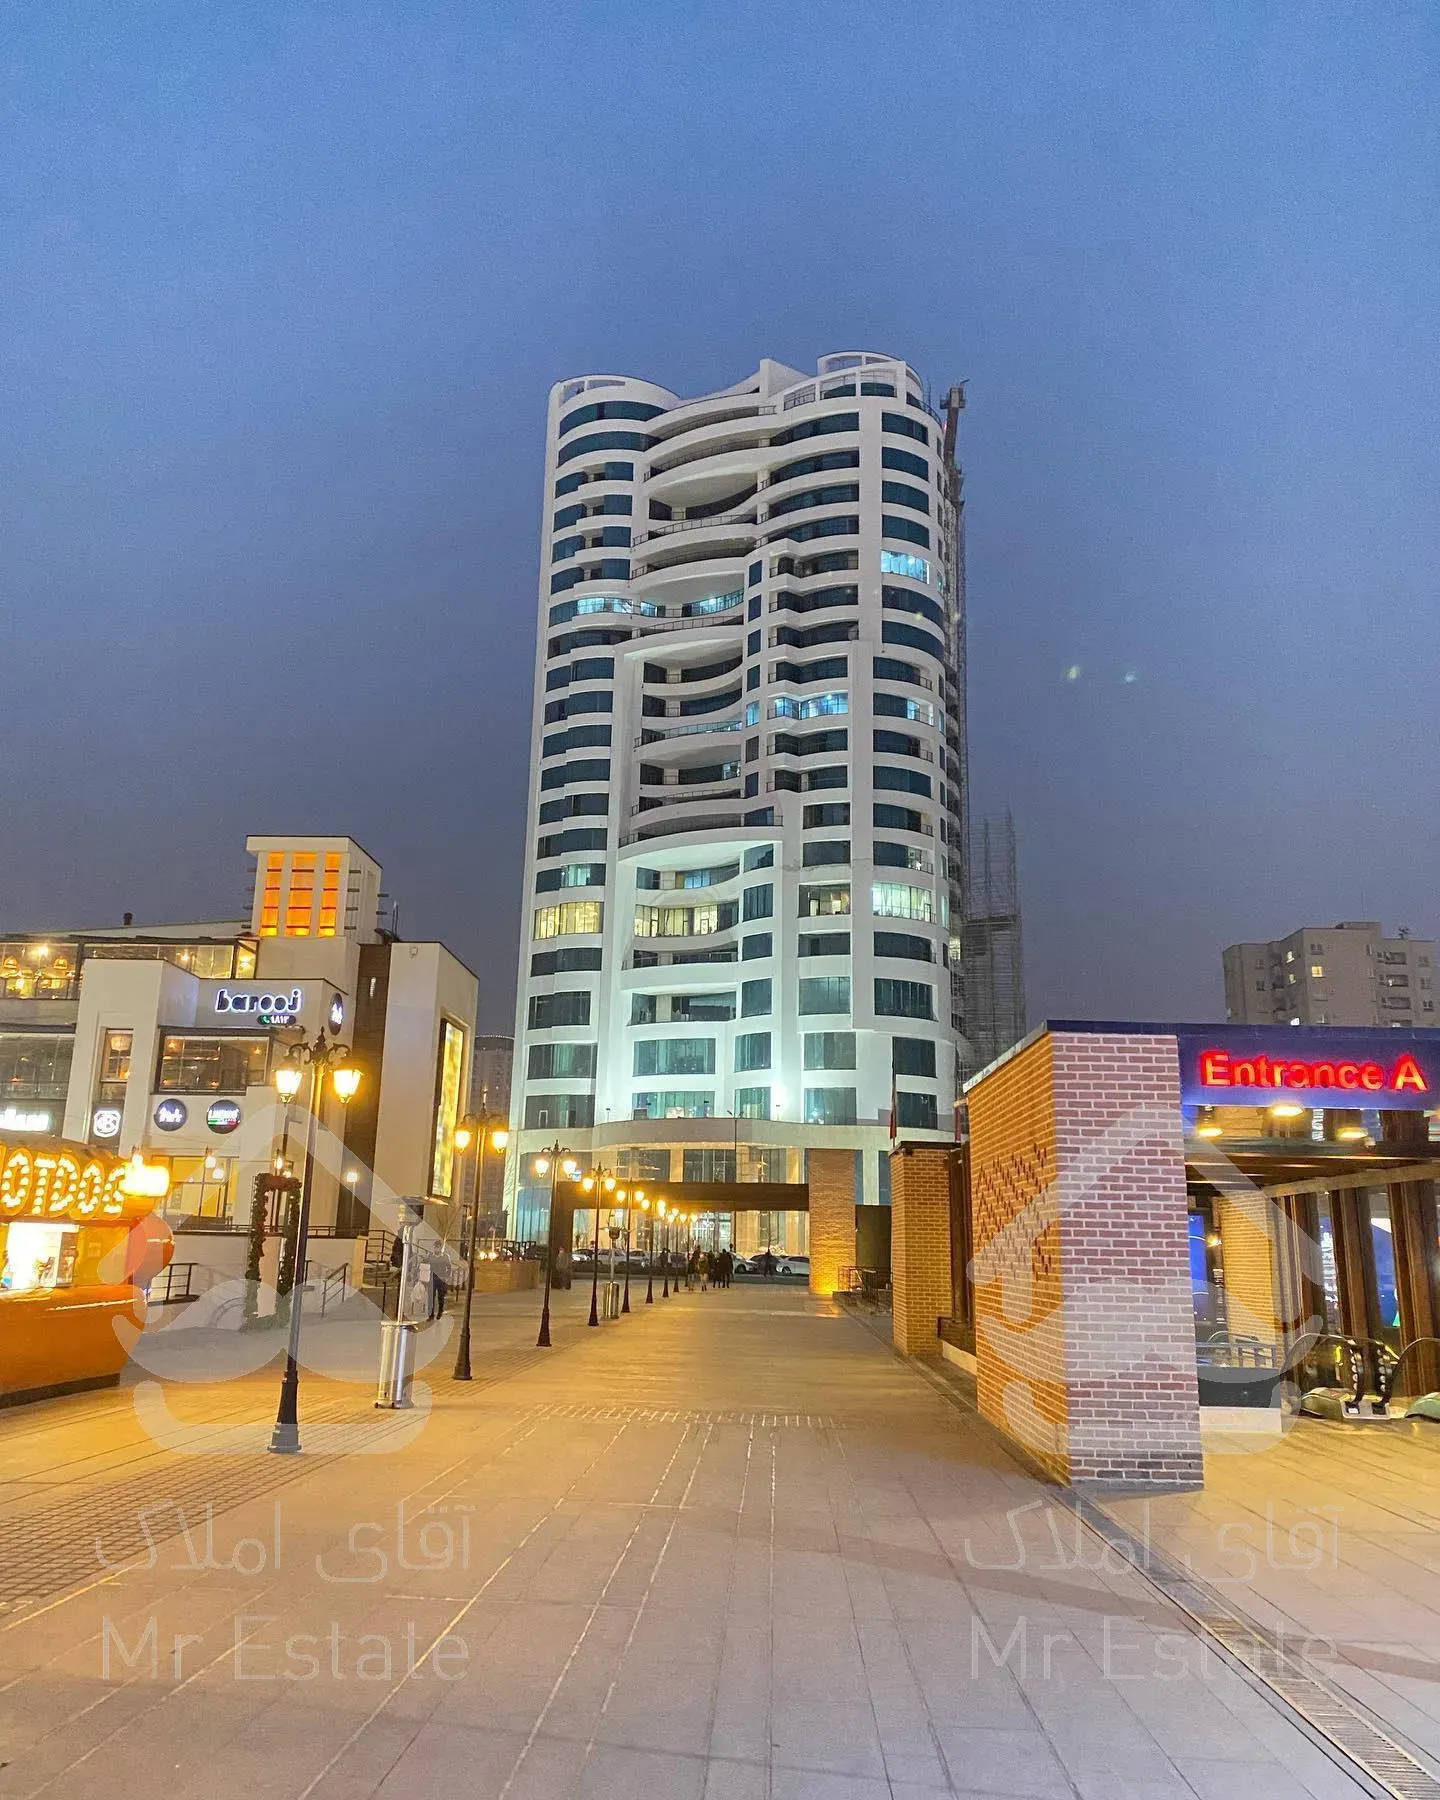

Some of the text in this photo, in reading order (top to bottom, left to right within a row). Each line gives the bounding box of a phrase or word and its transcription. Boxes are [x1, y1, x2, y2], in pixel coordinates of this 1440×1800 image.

[215, 988, 301, 1012] barooj
[1201, 1050, 1428, 1092] Entrance A
[0, 1143, 127, 1220] OTDOG
